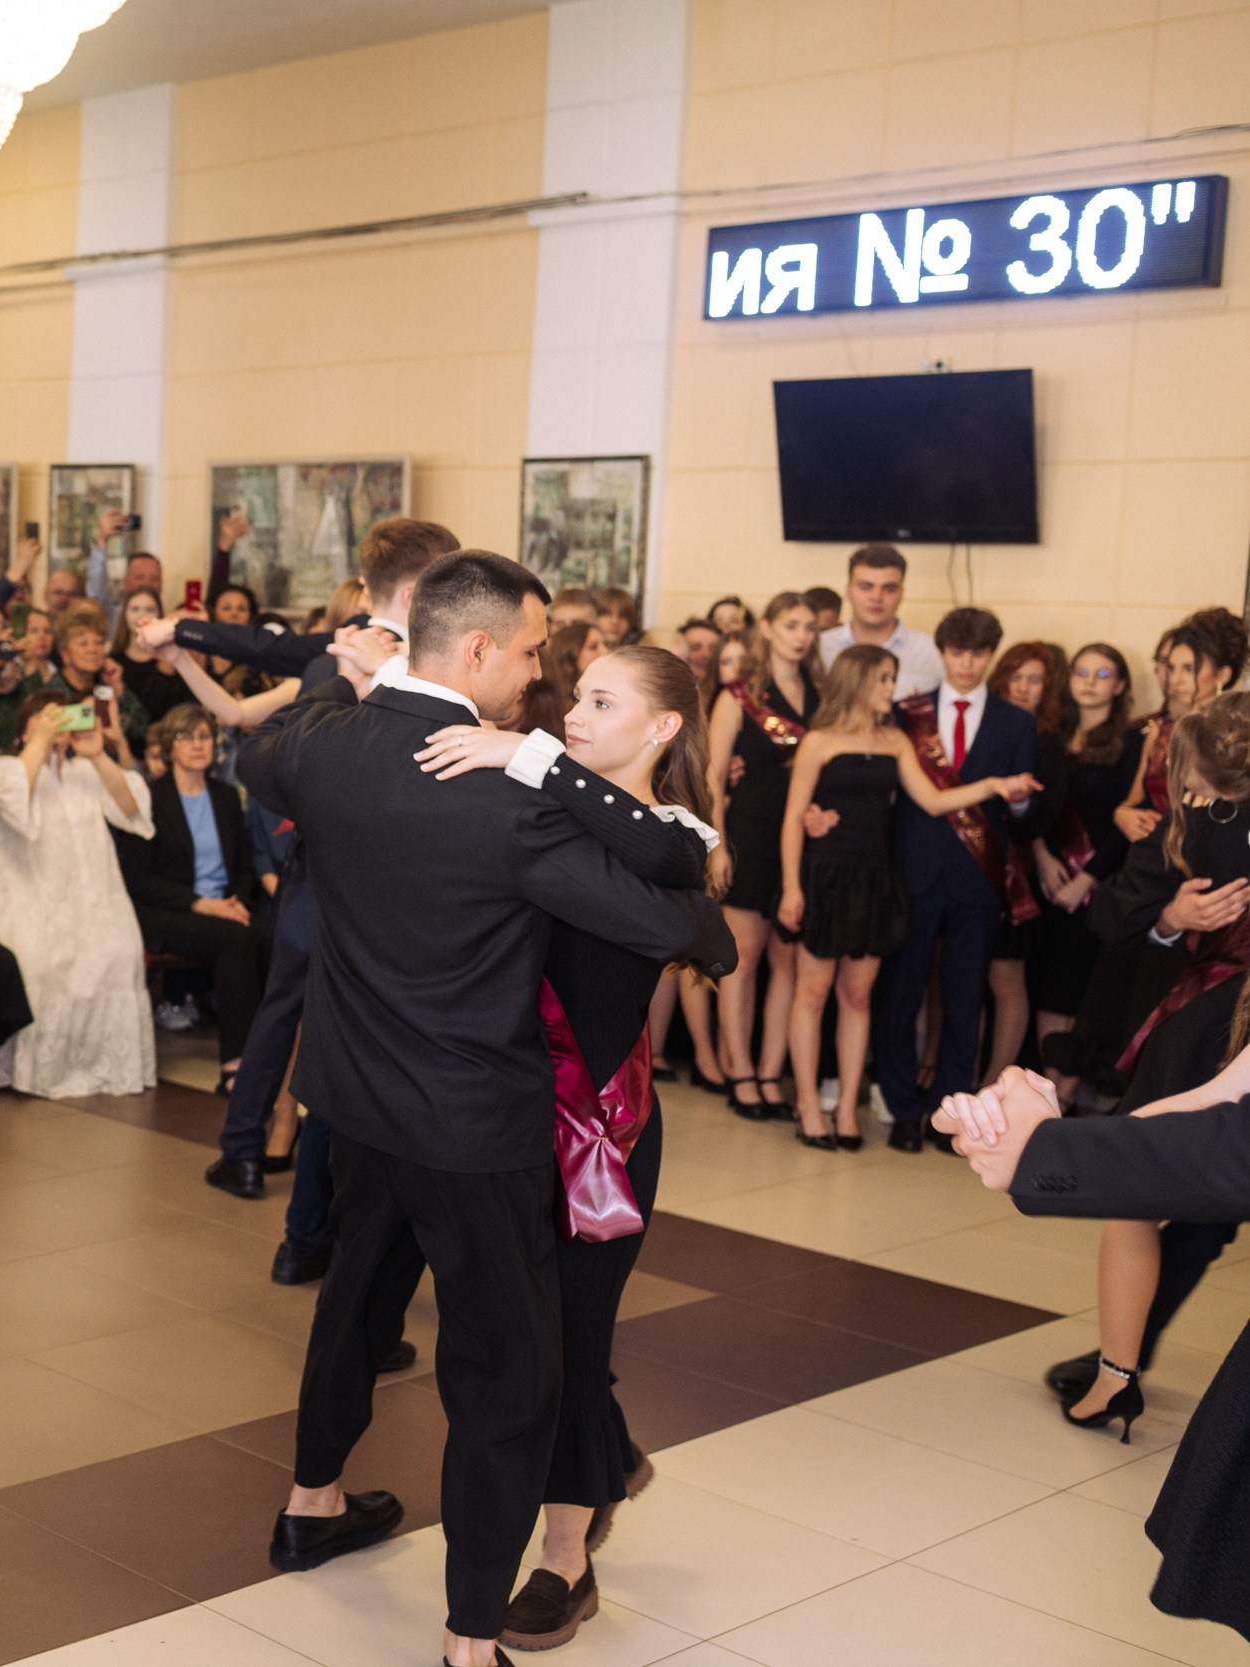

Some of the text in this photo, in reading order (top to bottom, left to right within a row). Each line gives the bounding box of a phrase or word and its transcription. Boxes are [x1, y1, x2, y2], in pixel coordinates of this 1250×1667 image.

[708, 181, 1196, 318] ия № 30"
